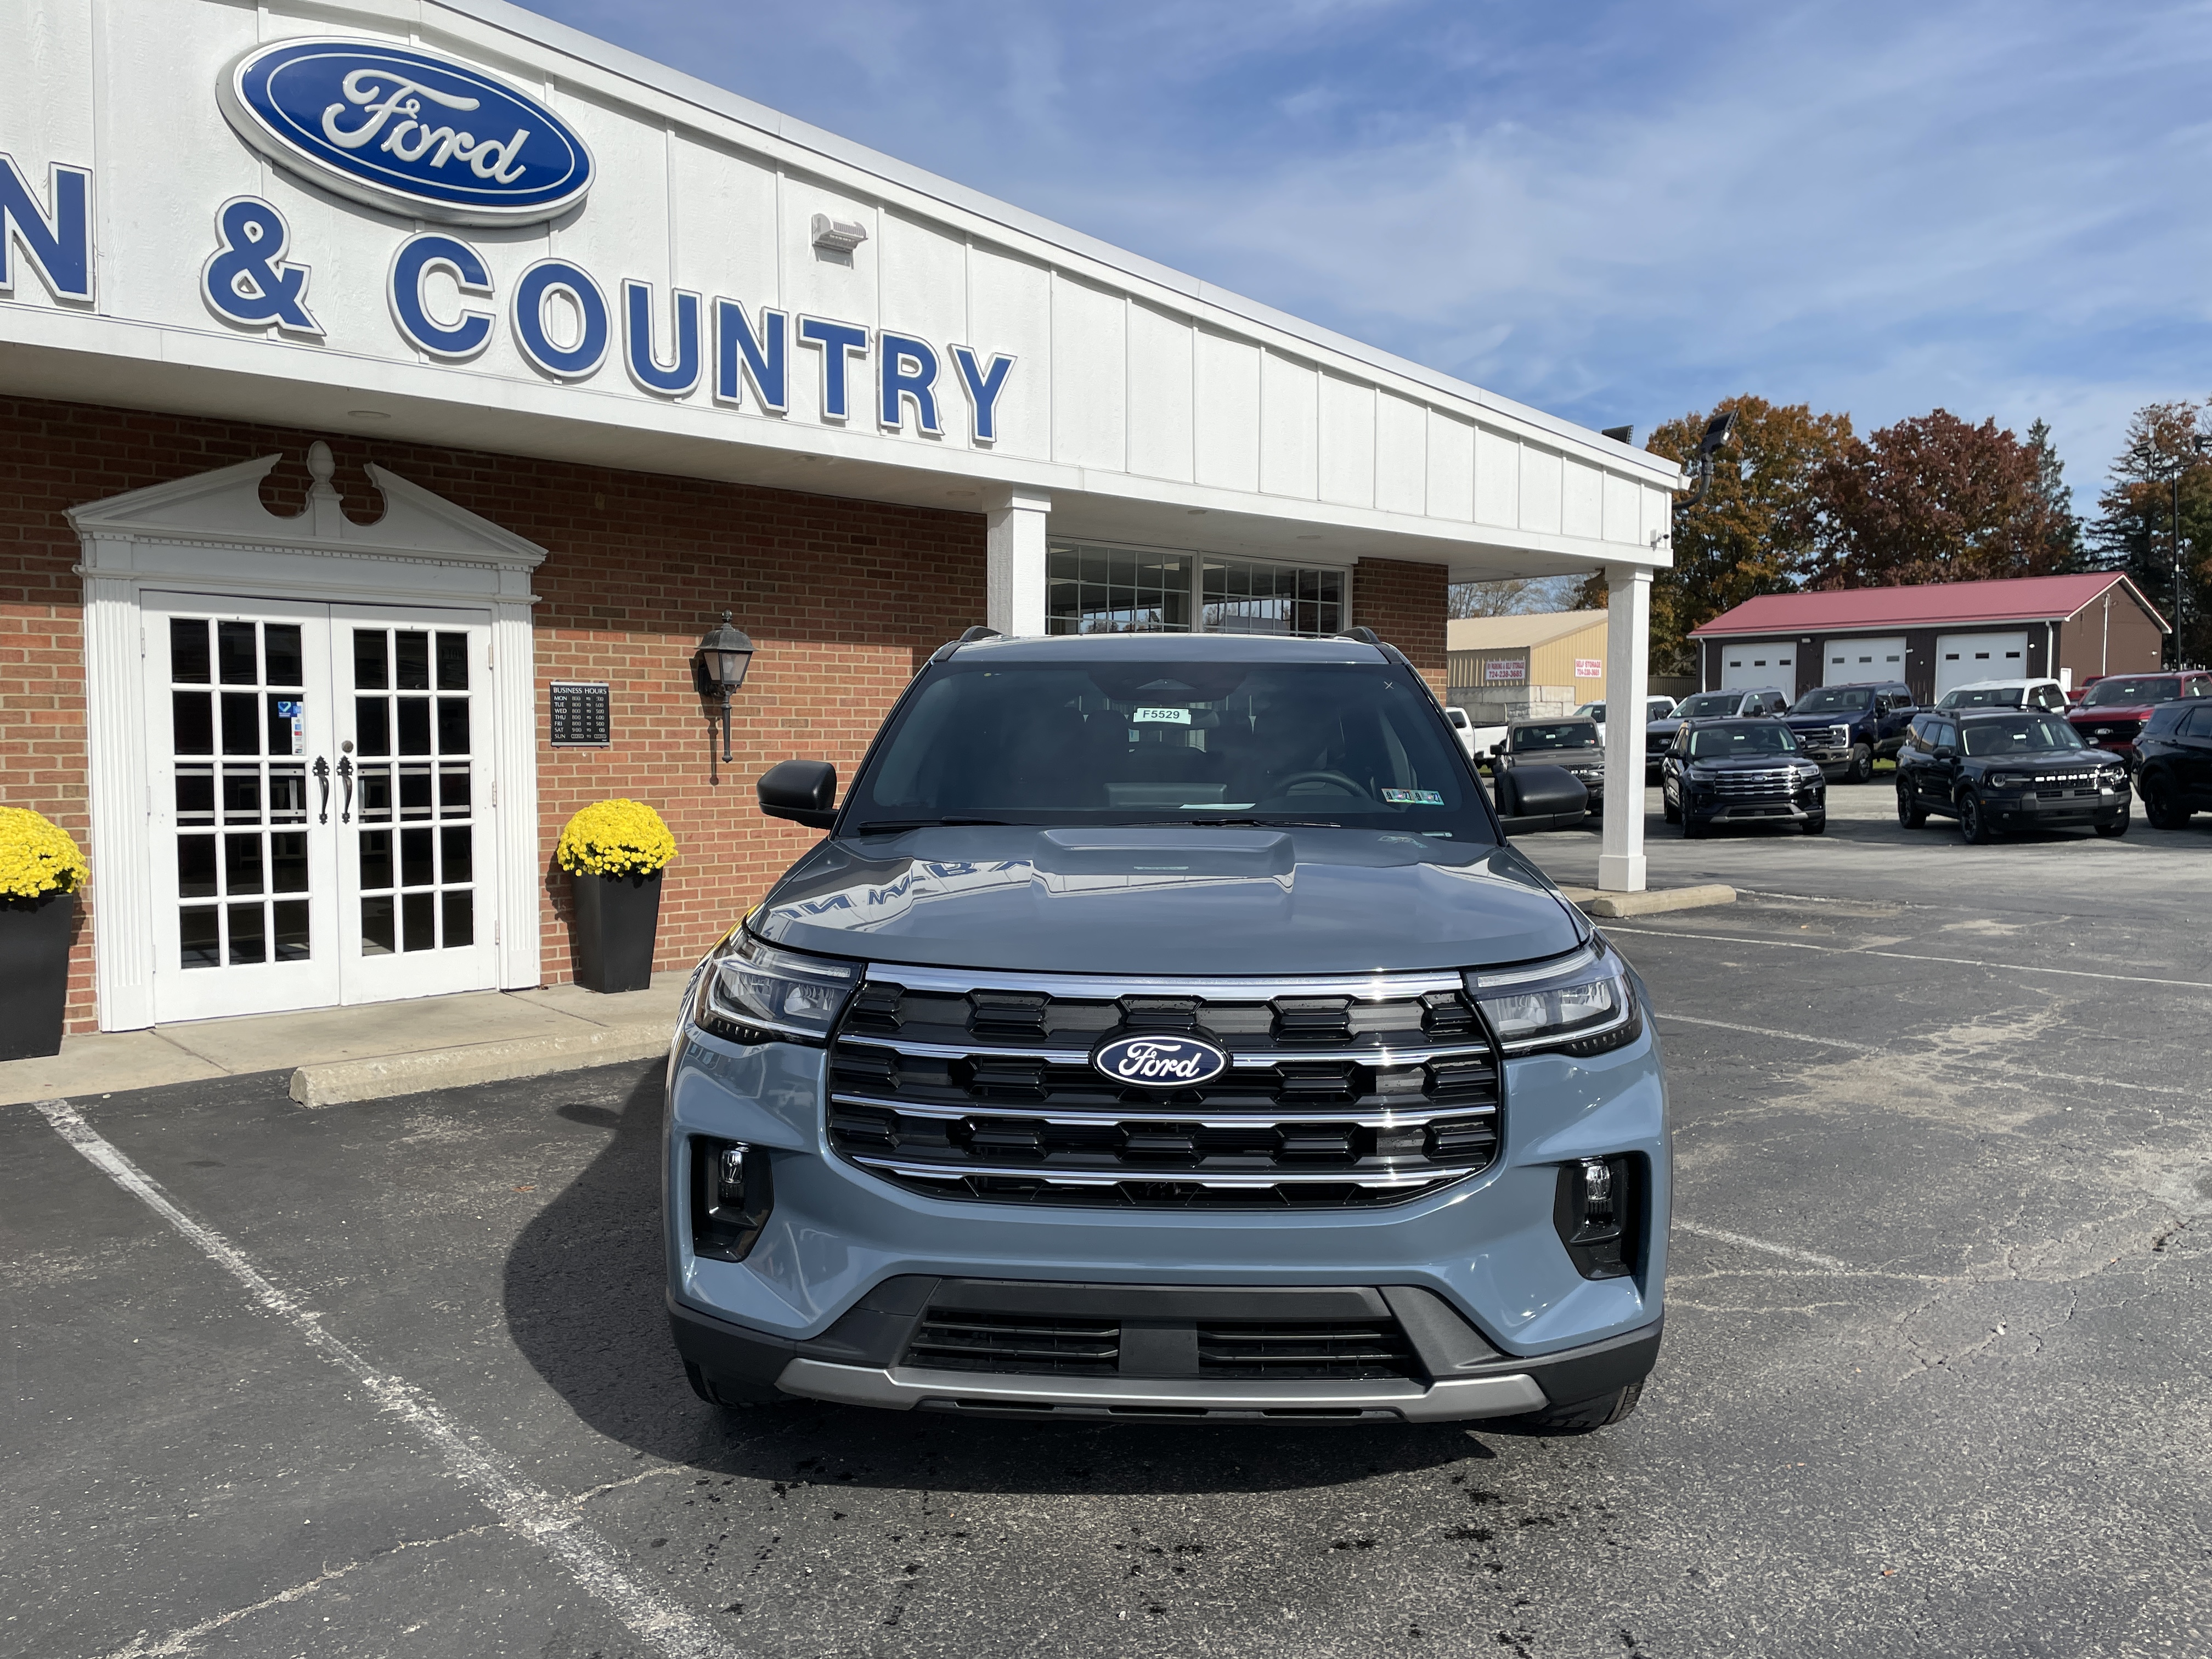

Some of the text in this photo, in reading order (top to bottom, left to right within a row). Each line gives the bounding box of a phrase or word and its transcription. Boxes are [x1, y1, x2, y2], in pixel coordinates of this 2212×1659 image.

[321, 69, 531, 184] Ford
[201, 195, 327, 337] &
[386, 230, 1018, 443] COUNTRY
[1143, 709, 1180, 719] F5529
[1118, 1042, 1202, 1077] Ford
